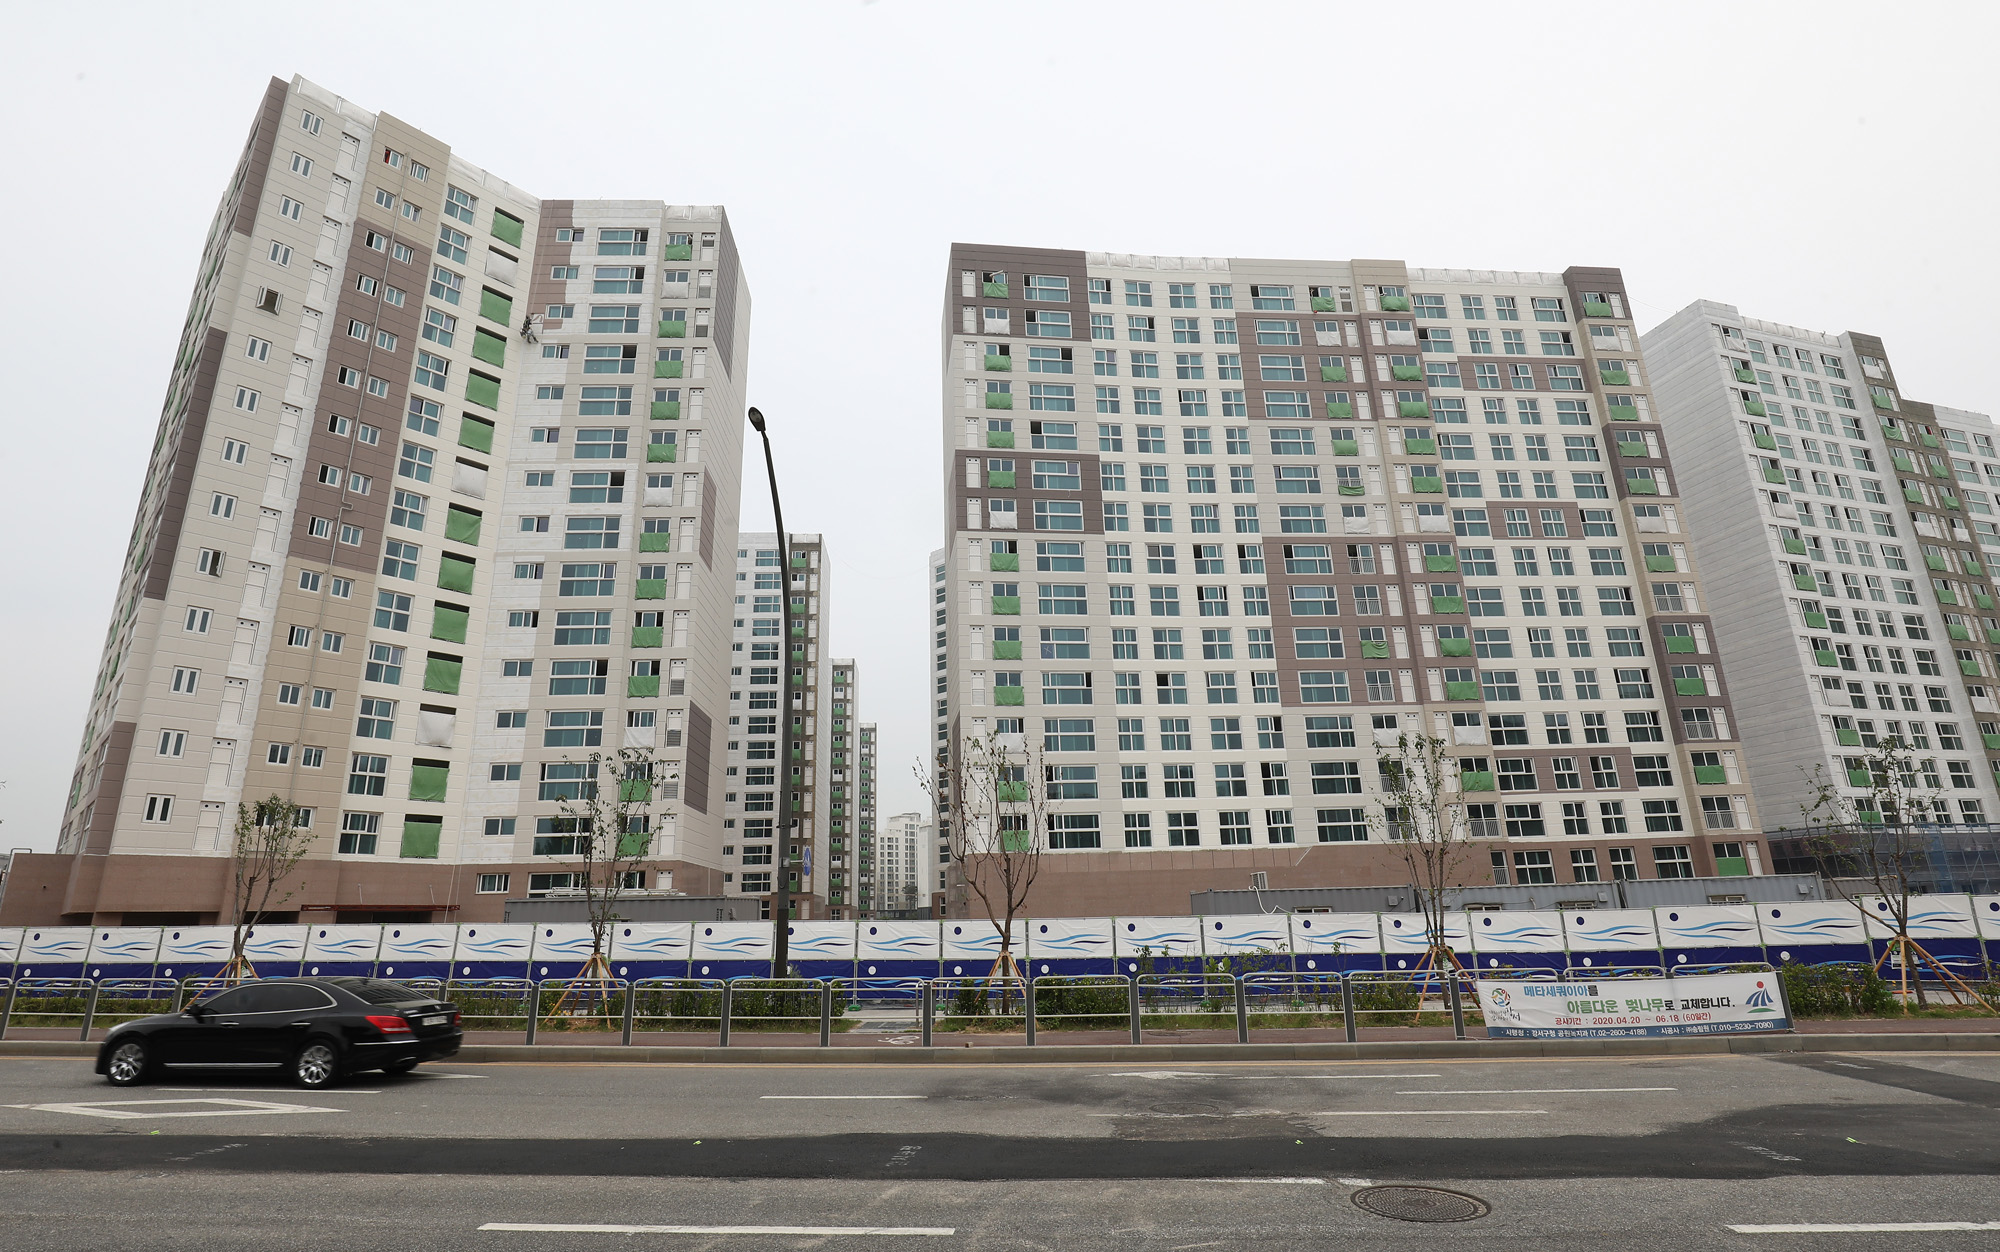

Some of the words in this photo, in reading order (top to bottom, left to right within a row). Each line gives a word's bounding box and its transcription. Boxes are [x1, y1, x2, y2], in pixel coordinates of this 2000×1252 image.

[1523, 984, 1599, 997] 메타세쿼이아를
[1567, 999, 1619, 1014] 아름다운
[1625, 998, 1675, 1013] 벚나무로
[1680, 996, 1736, 1010] 교체합니다.
[1554, 1017, 1582, 1026] 공사기간
[1592, 1016, 1641, 1025] 2020.04.20
[1655, 1014, 1680, 1023] 06.18
[1682, 1011, 1712, 1023] (60일간)
[1531, 1029, 1556, 1037] 강서구청
[1661, 1026, 1680, 1035] 시공사
